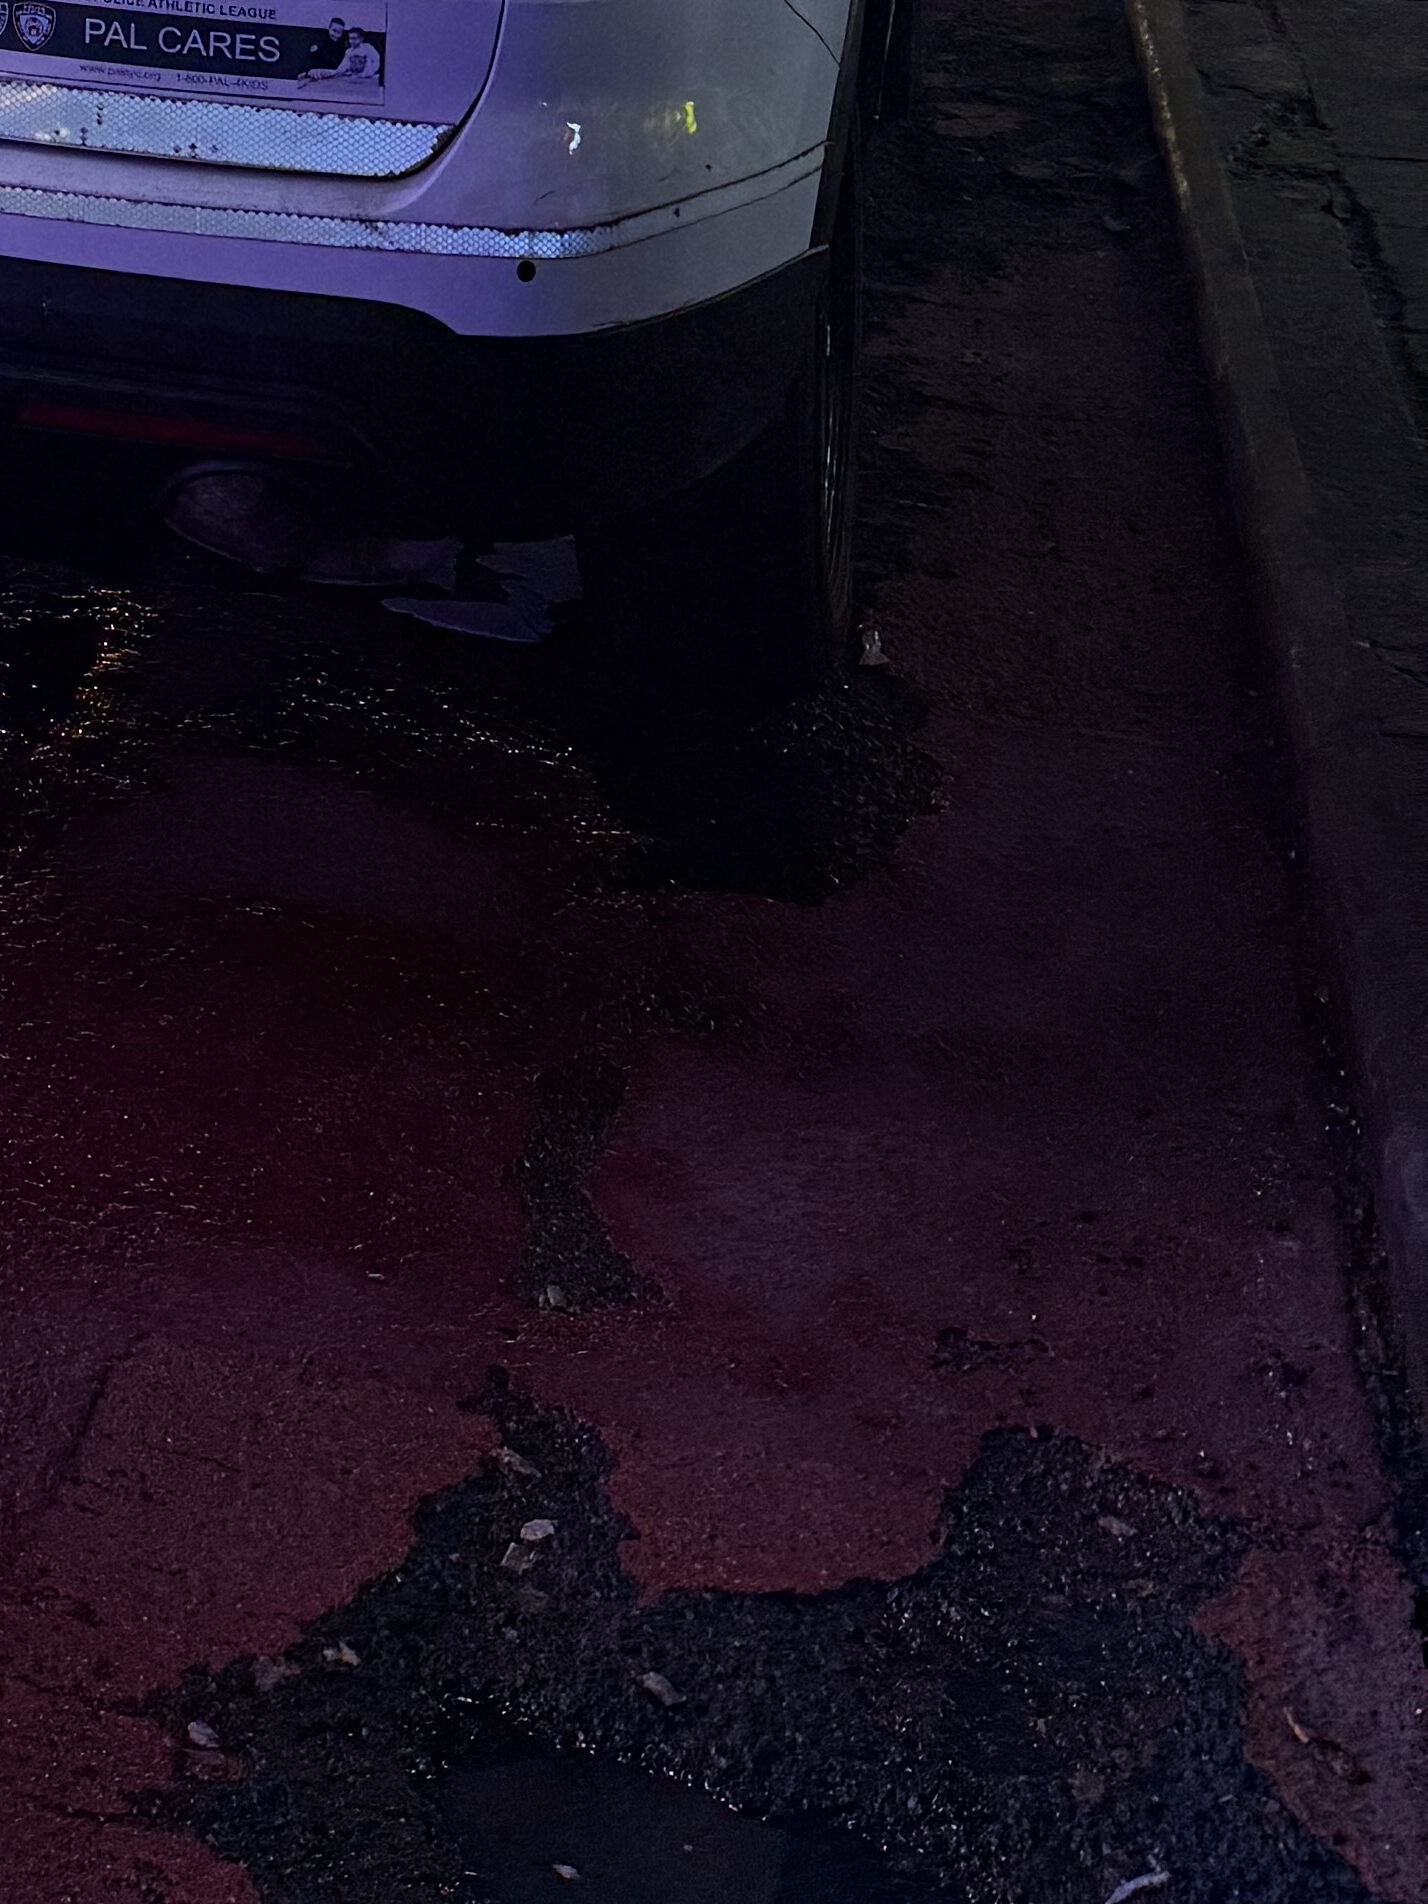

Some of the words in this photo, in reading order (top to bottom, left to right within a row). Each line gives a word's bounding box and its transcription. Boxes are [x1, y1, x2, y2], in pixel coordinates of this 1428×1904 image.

[219, 3, 277, 21] LEAGUE
[84, 17, 147, 52] PAL
[157, 25, 281, 64] CARES
